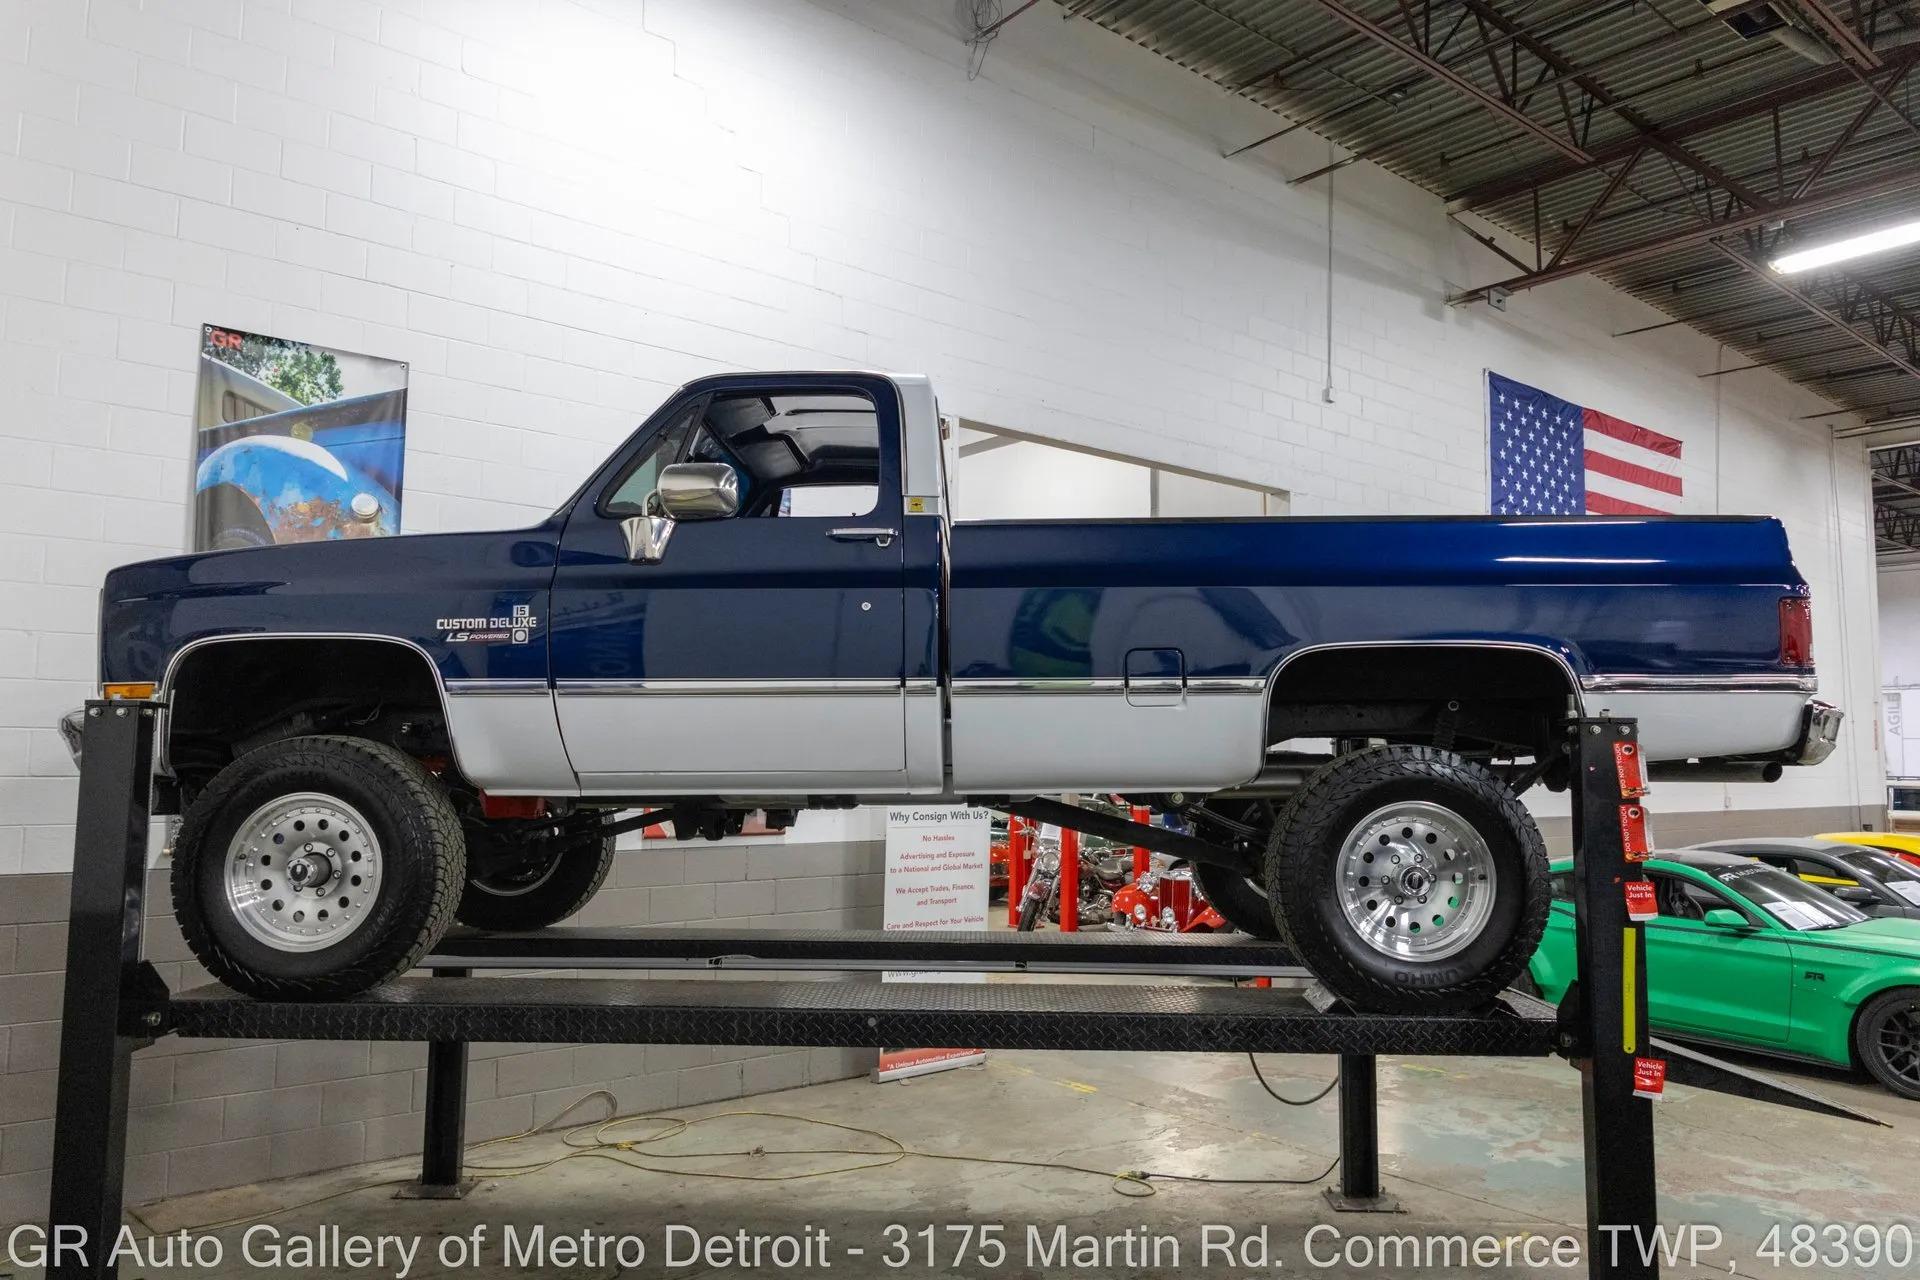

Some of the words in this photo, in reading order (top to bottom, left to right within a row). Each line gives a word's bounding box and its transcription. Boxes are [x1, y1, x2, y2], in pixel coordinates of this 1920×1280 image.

[210, 330, 242, 350] GR
[436, 618, 487, 630] CUSTOM
[489, 616, 537, 629] DELUXE
[446, 632, 469, 642] LS
[889, 811, 910, 824] Why
[912, 811, 948, 822] Consign
[950, 810, 970, 820] With
[973, 810, 989, 820] Us?
[1620, 806, 1628, 827] TOUCH
[1625, 842, 1631, 852] DO
[900, 852, 935, 860] Advertising
[948, 851, 975, 860] Exposure
[942, 863, 961, 871] Global
[907, 886, 929, 895] Accept
[929, 897, 957, 906] Transport
[887, 922, 901, 930] Care
[902, 921, 914, 929] and
[914, 919, 939, 928] Respect
[949, 917, 963, 925] Your
[963, 915, 984, 923] Vehicle
[895, 1061, 914, 1069] Unique
[915, 1055, 945, 1064] Automotive
[1637, 1061, 1662, 1069] Vehicle
[1637, 1067, 1653, 1076] Just
